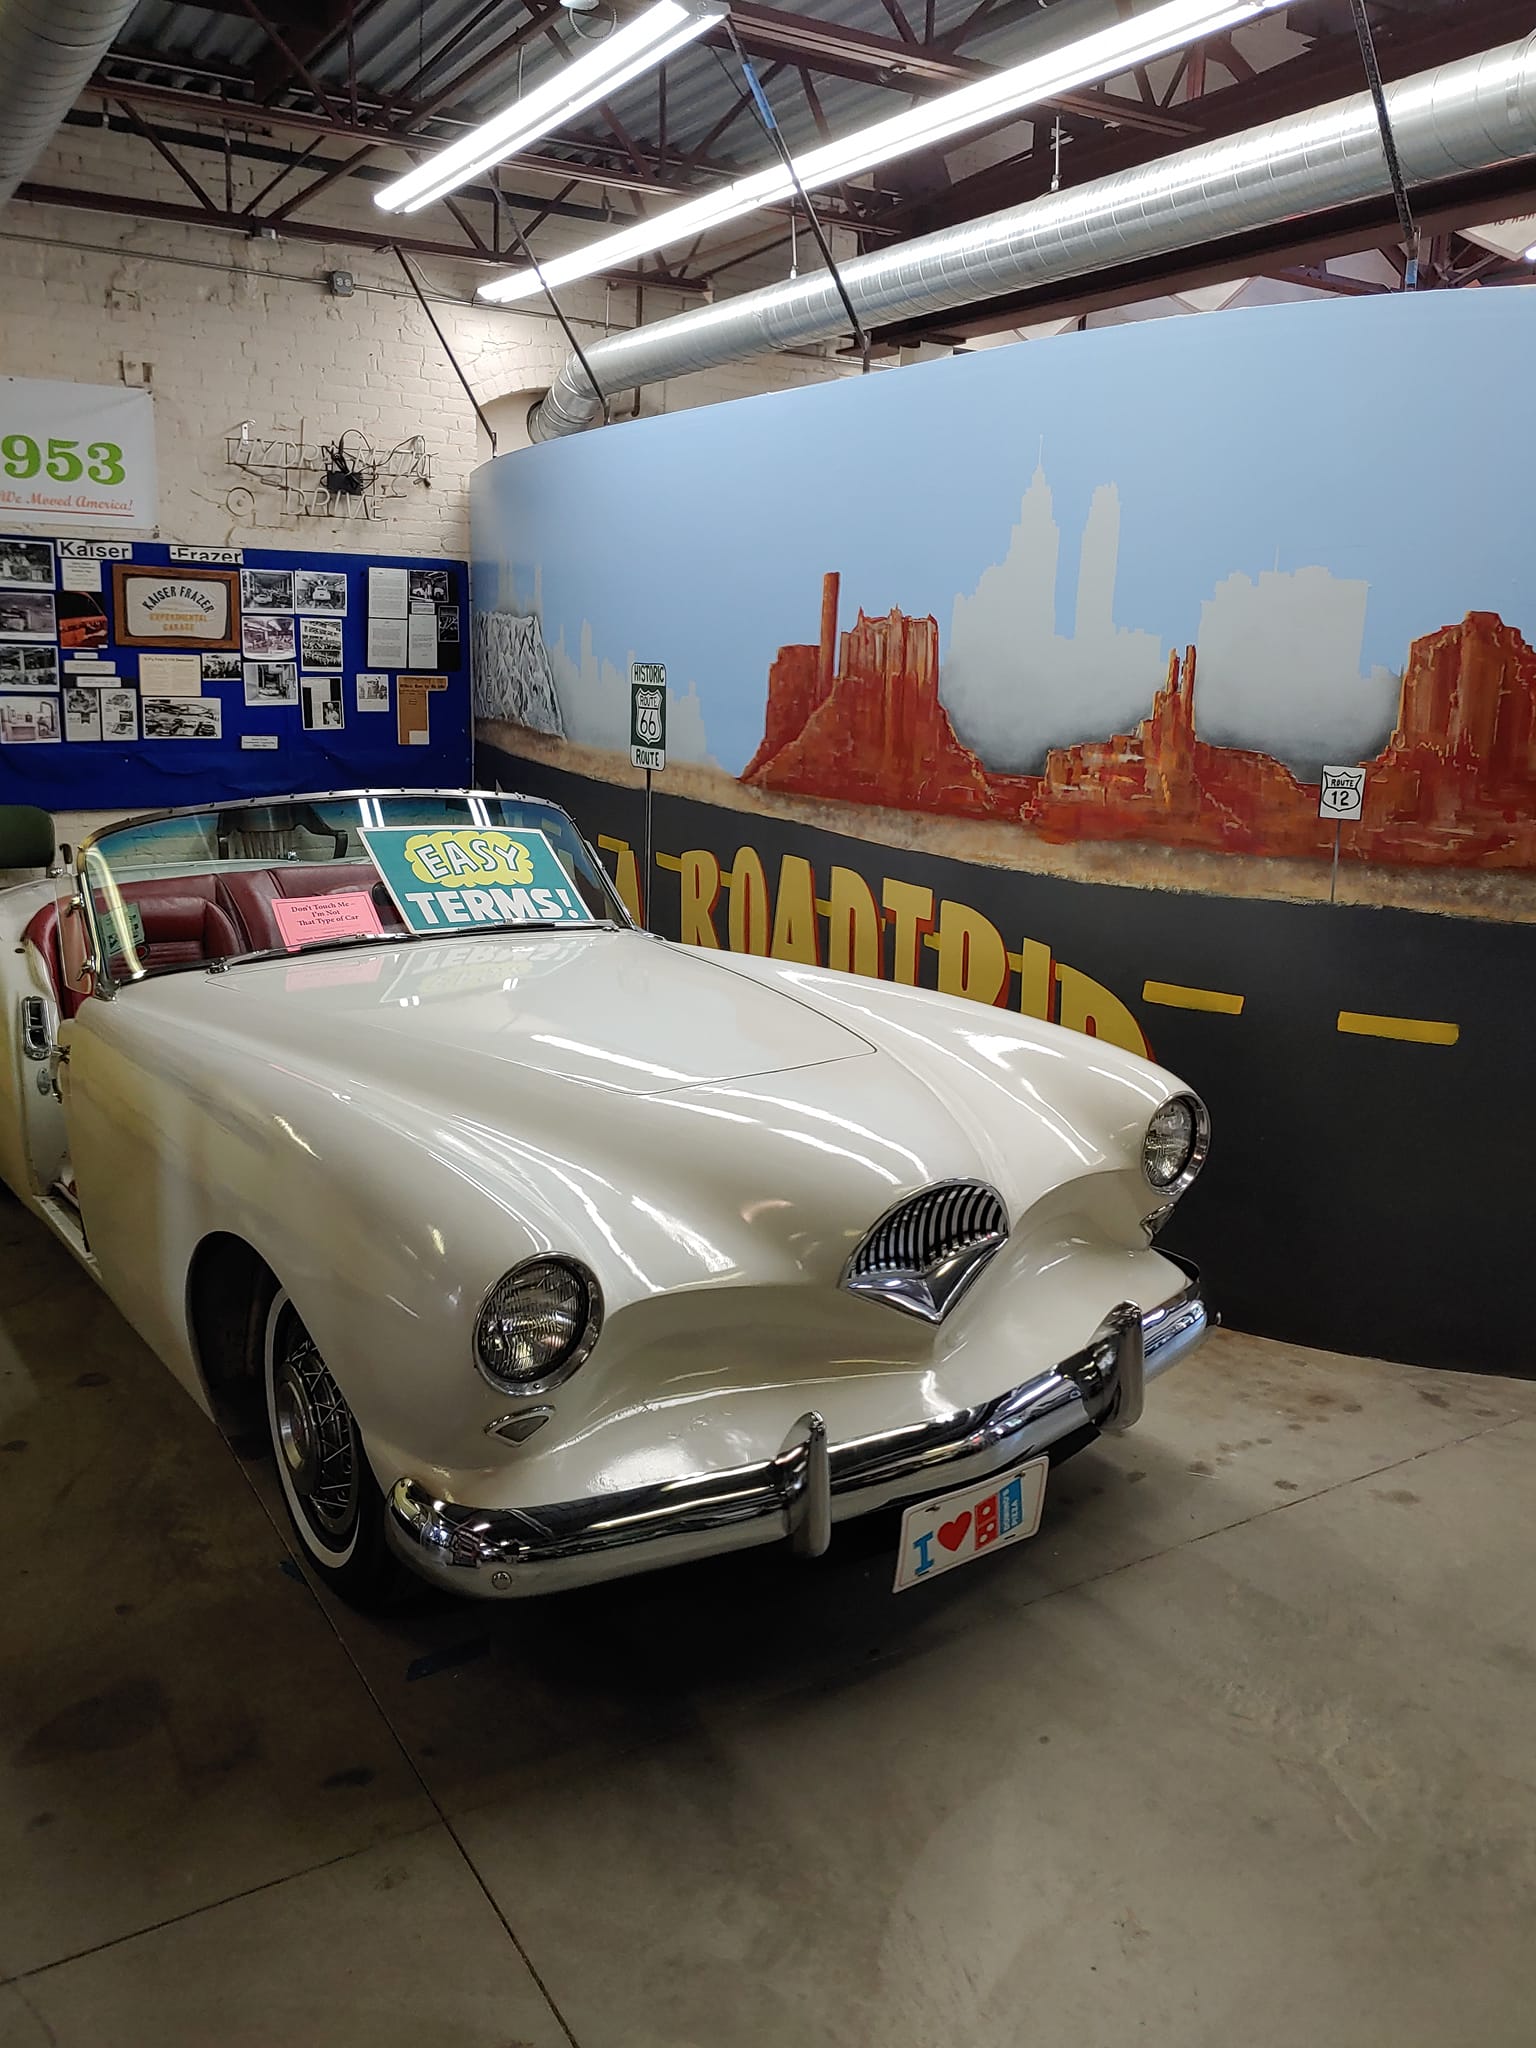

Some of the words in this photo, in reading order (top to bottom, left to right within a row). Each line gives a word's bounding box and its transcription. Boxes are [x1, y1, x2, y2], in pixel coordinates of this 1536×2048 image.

[0, 434, 126, 486] 953
[26, 491, 72, 506] Moved
[75, 496, 133, 511] America!
[60, 541, 129, 558] Kaiser
[142, 586, 177, 611] KAISER
[180, 586, 215, 613] FRAZER
[634, 665, 665, 683] HISTORIC
[640, 695, 658, 707] ROUTE
[640, 710, 657, 736] 66
[635, 748, 660, 767] ROUTE
[1331, 778, 1354, 787] ROUTE
[1331, 790, 1349, 806] 12
[415, 839, 520, 879] EASY
[291, 904, 312, 913] Don't
[313, 902, 336, 911] Touch
[326, 909, 341, 917] Not
[405, 888, 579, 925] TERMS!
[316, 917, 335, 926] Type
[336, 914, 345, 922] of
[913, 1530, 935, 1576] I
